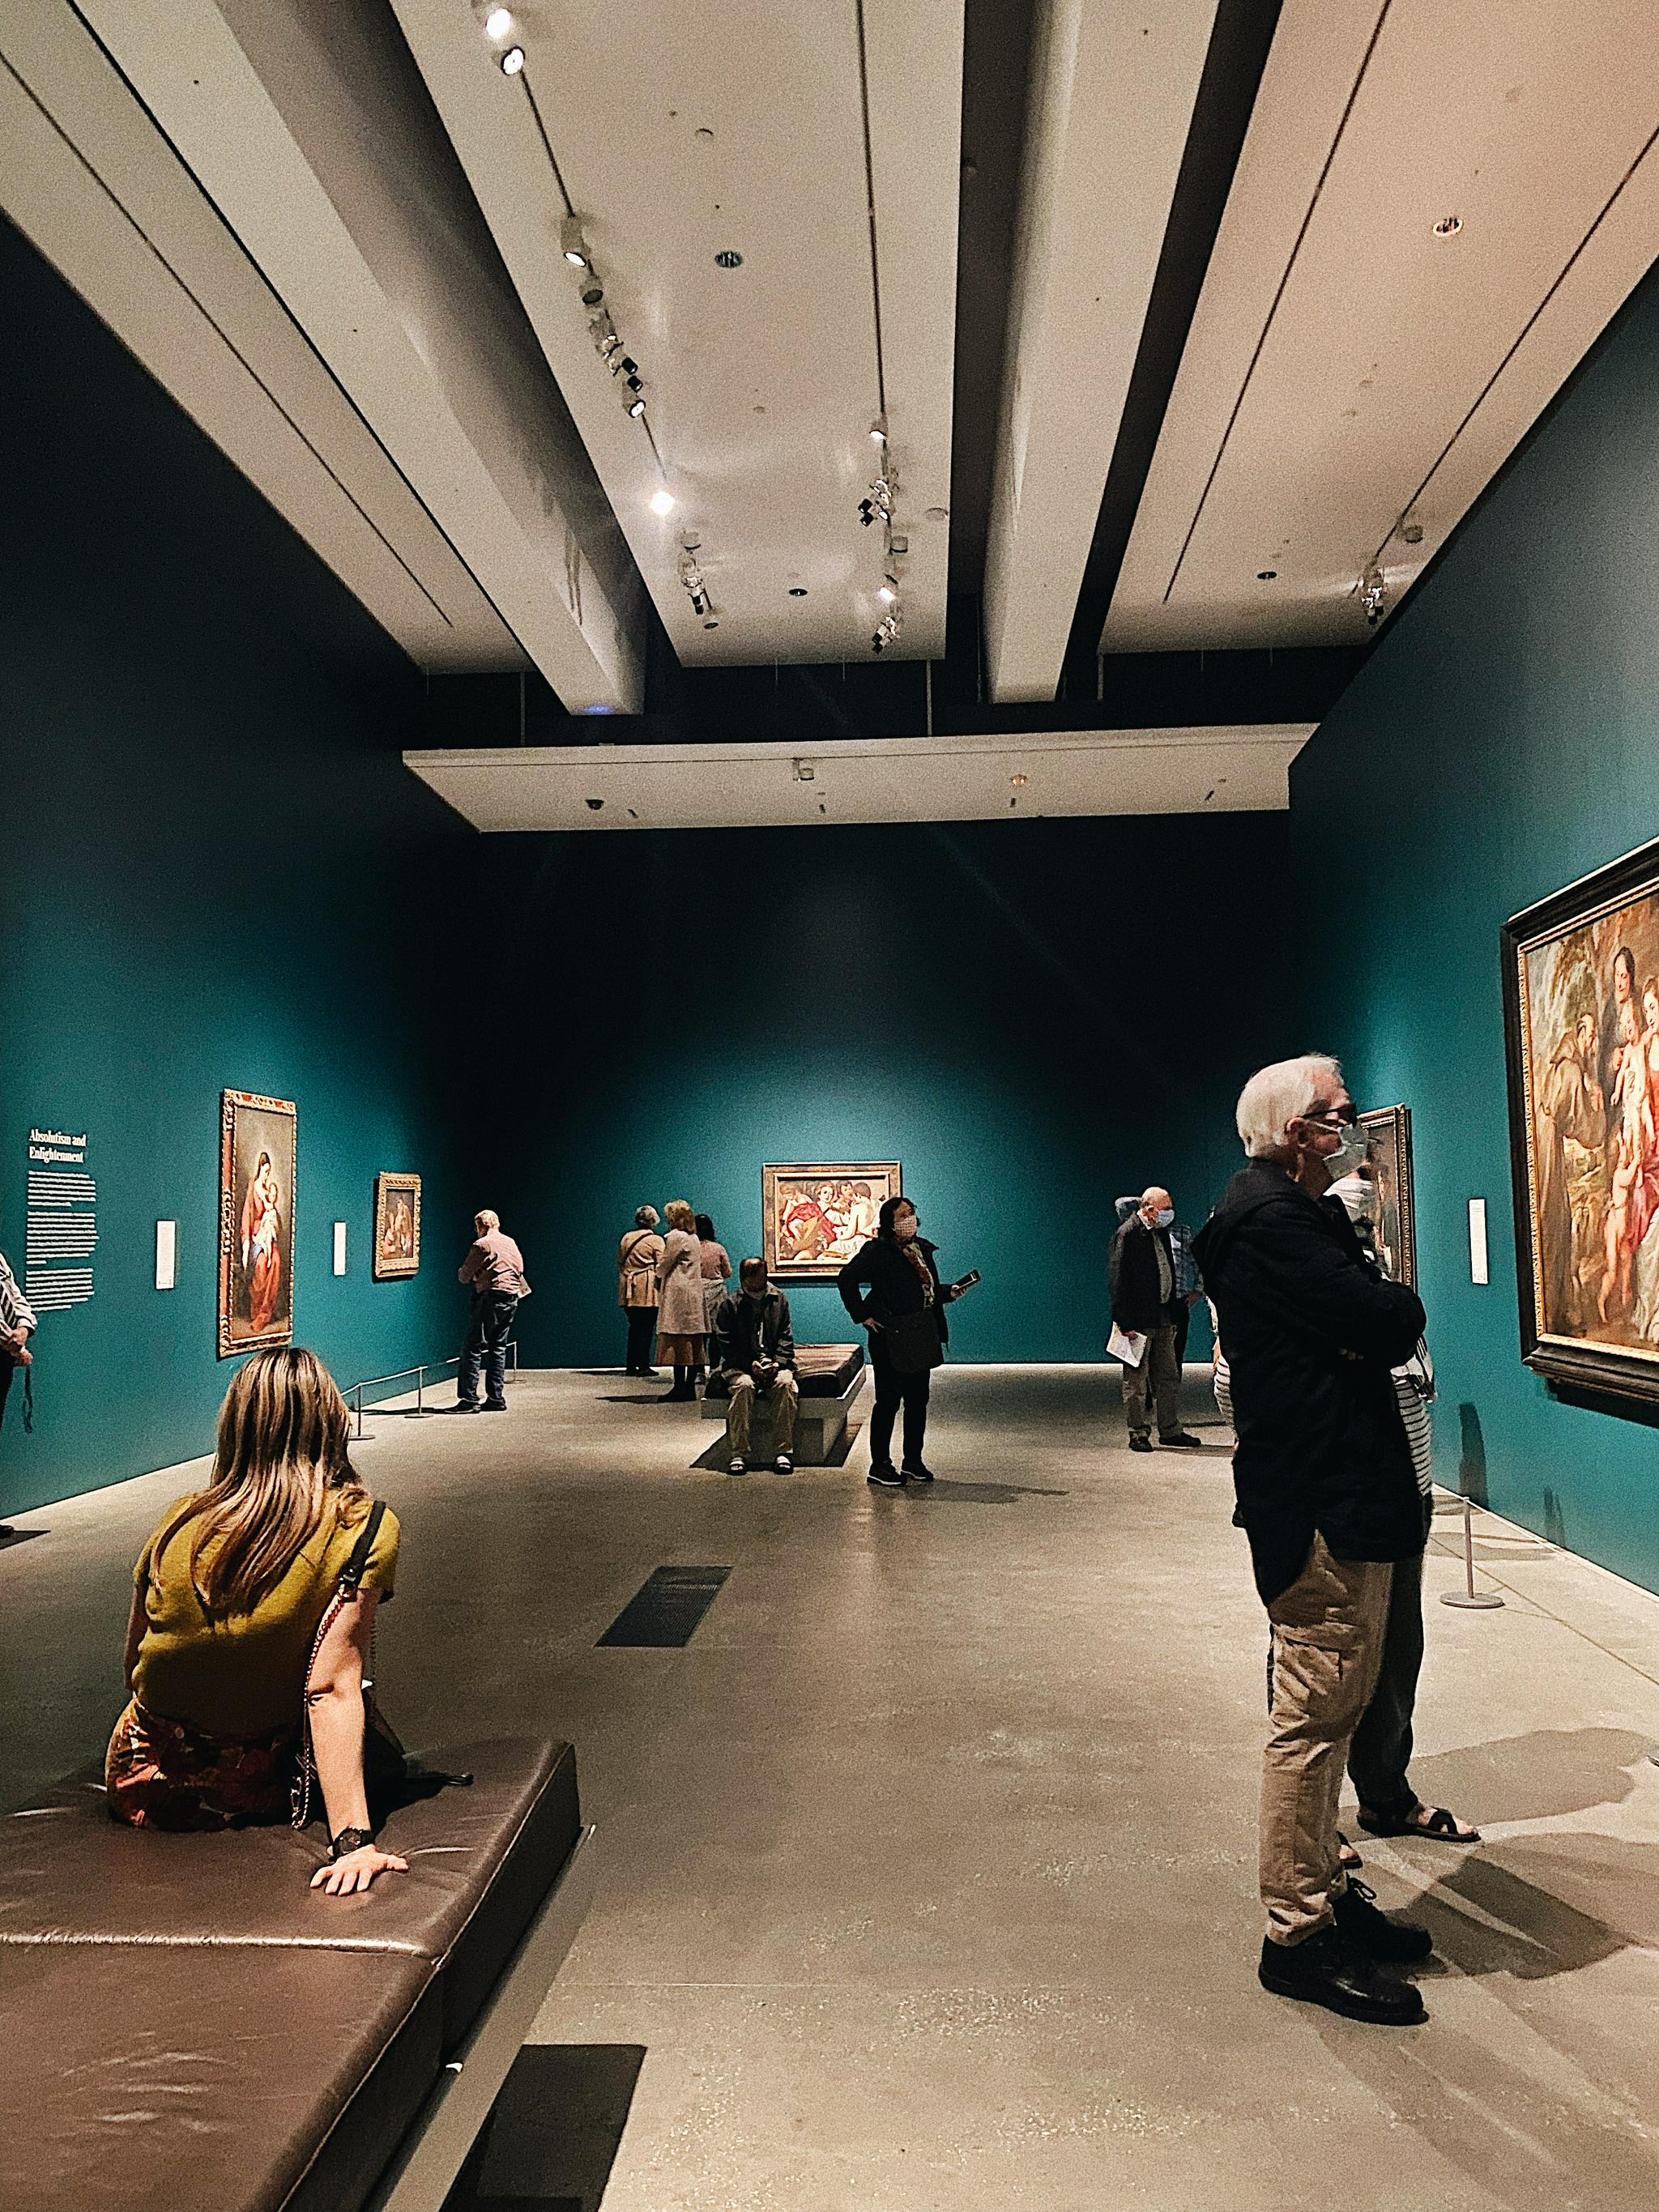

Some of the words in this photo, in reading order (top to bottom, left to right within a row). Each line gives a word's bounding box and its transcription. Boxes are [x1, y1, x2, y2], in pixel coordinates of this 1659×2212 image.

[28, 1128, 71, 1145] Absolutism
[71, 1133, 87, 1147] and
[29, 1146, 84, 1164] Enlightenment
